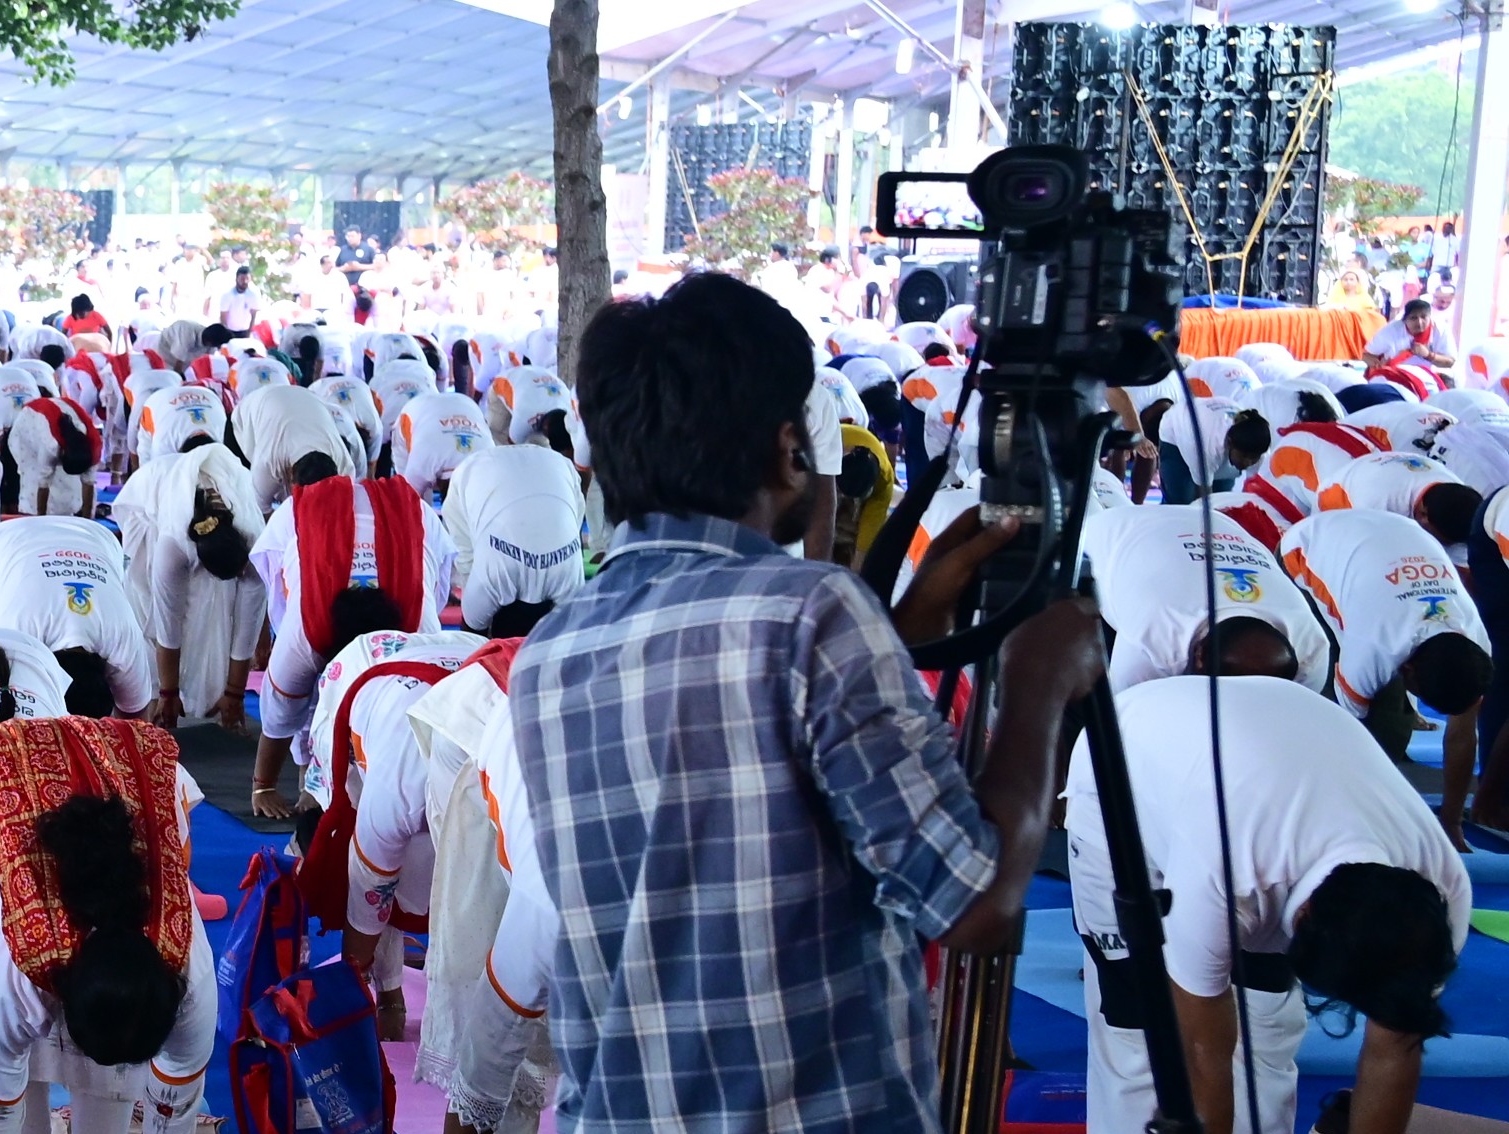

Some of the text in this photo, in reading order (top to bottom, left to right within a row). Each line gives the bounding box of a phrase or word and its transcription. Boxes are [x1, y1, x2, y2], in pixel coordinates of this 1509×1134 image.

[489, 534, 522, 563] KENDRA
[41, 560, 108, 575] ଯୋଗ ଦିବସ
[1384, 563, 1455, 586] YOGA
[44, 569, 107, 584] ଅନ୍ତର୍ଜାତୀୟ
[1410, 579, 1440, 588] DAY OF
[1395, 587, 1458, 602] INTERNATIONAL
